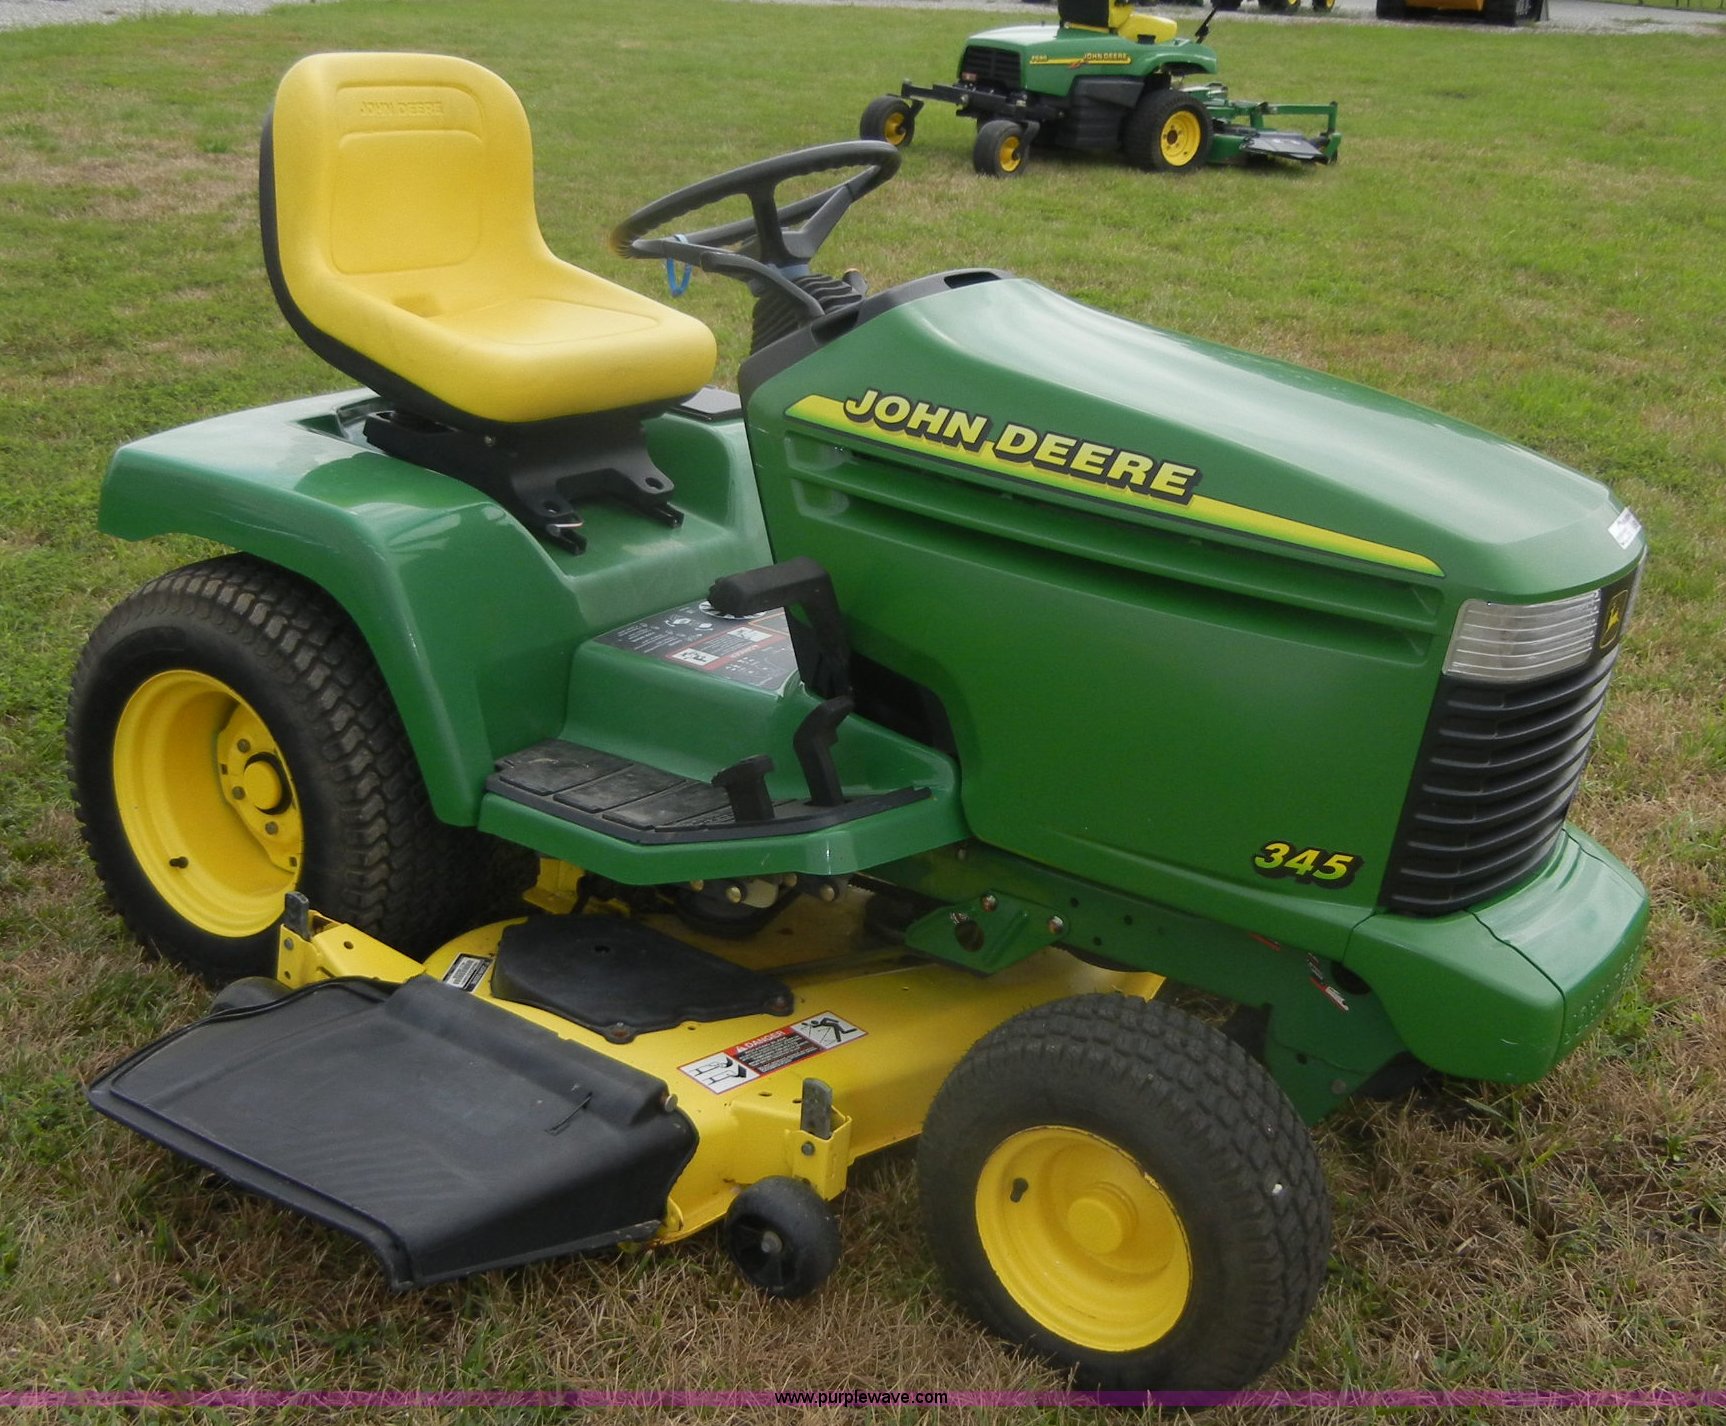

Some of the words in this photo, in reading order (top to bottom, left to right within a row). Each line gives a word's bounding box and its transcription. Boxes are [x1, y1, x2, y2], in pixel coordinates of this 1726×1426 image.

[844, 389, 991, 450] JOHN
[993, 423, 1201, 504] DEERE
[1253, 841, 1360, 886] 345
[745, 1030, 786, 1048] DANGER
